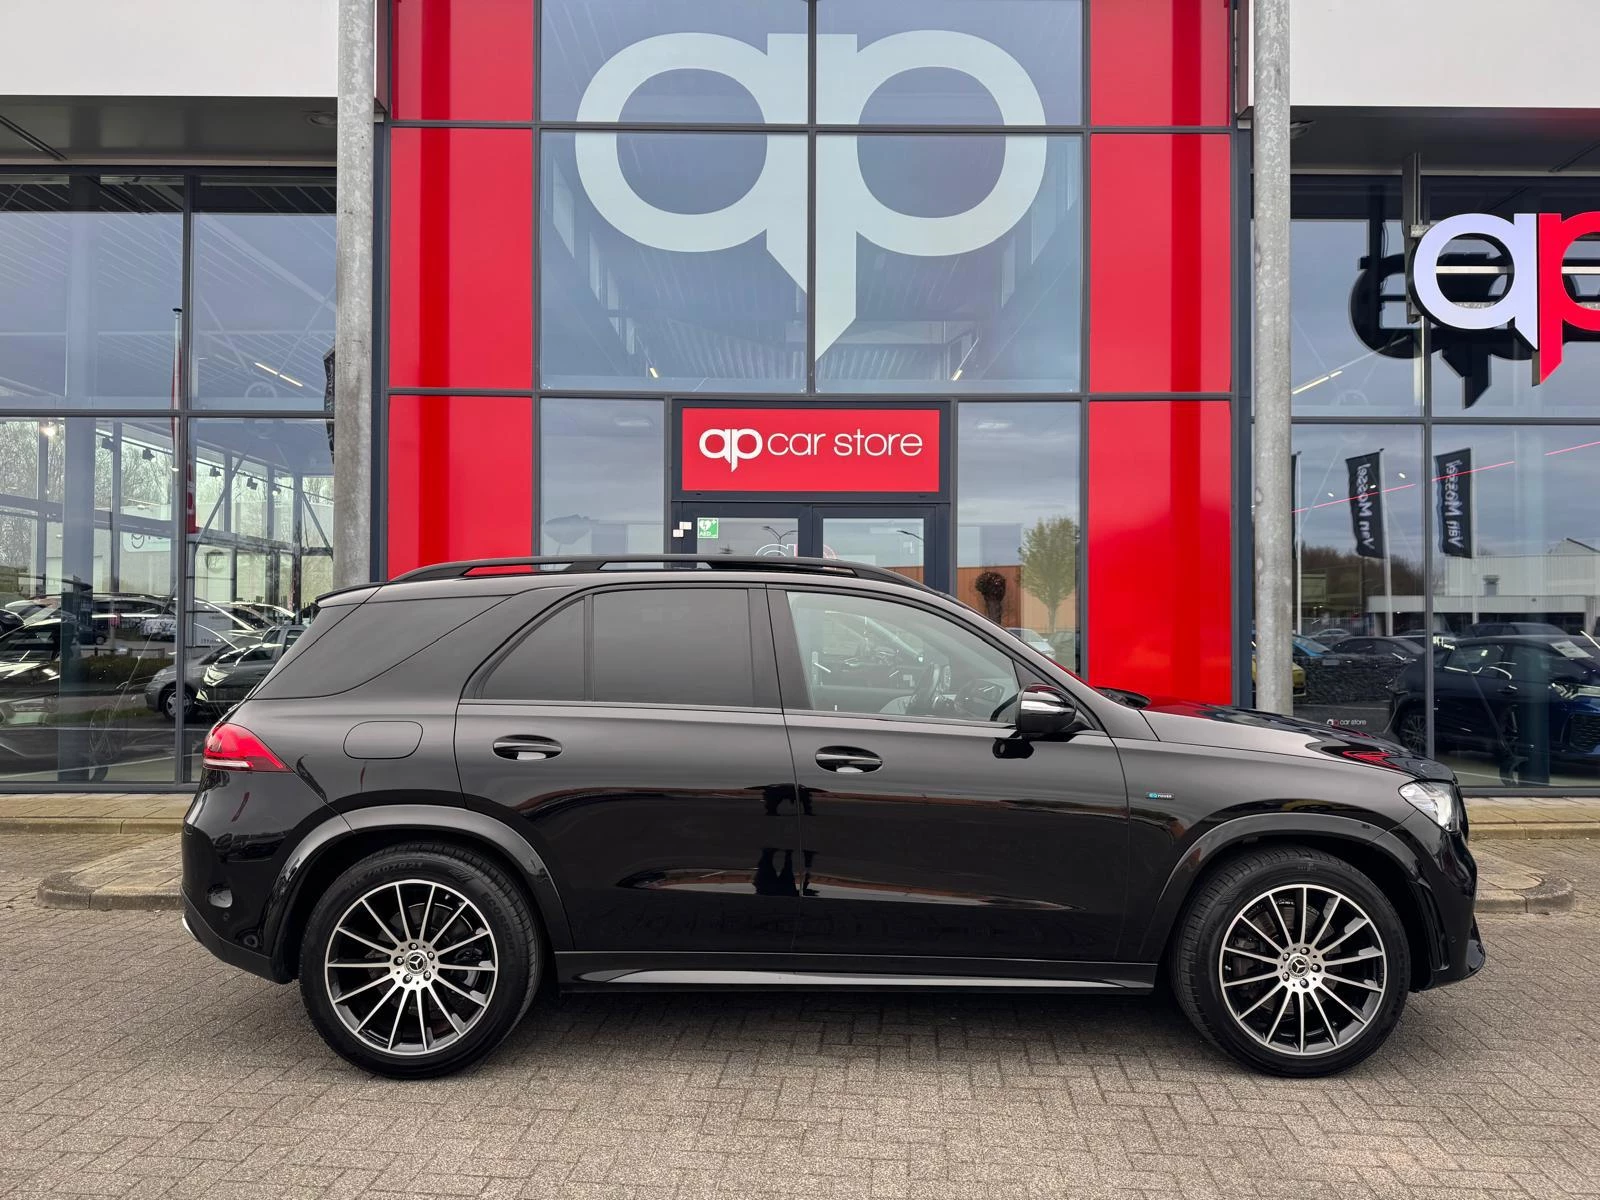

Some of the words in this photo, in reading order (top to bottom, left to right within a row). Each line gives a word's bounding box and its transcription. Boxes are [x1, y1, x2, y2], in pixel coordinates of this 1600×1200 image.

[575, 30, 1047, 361] ap
[699, 428, 763, 472] ap
[767, 433, 826, 456] car
[833, 428, 923, 456] store
